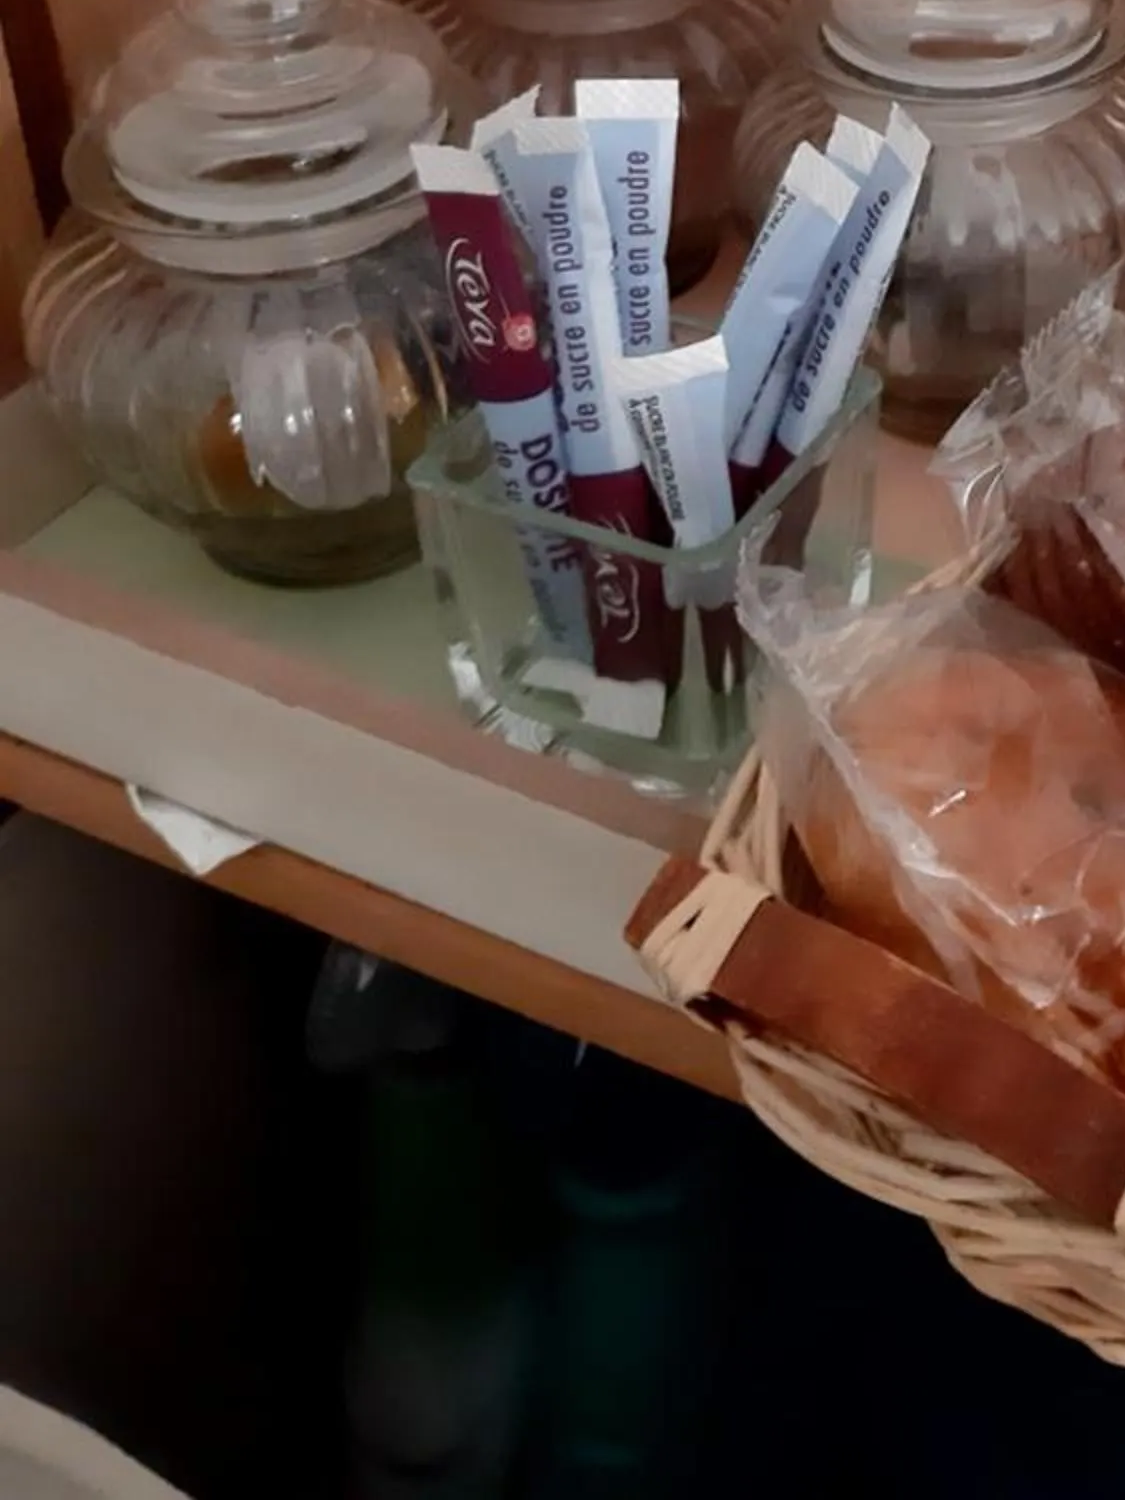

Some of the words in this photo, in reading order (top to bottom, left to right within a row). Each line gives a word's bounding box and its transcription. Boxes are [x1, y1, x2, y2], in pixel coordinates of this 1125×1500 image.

[618, 150, 656, 235] poudre
[541, 185, 583, 273] poudre
[629, 248, 650, 277] en
[806, 313, 836, 377] sucre
[833, 278, 851, 310] en
[849, 189, 891, 276] poudre
[558, 287, 581, 315] en
[629, 288, 651, 347] sucre
[564, 325, 593, 392] sucre
[571, 403, 599, 433] de
